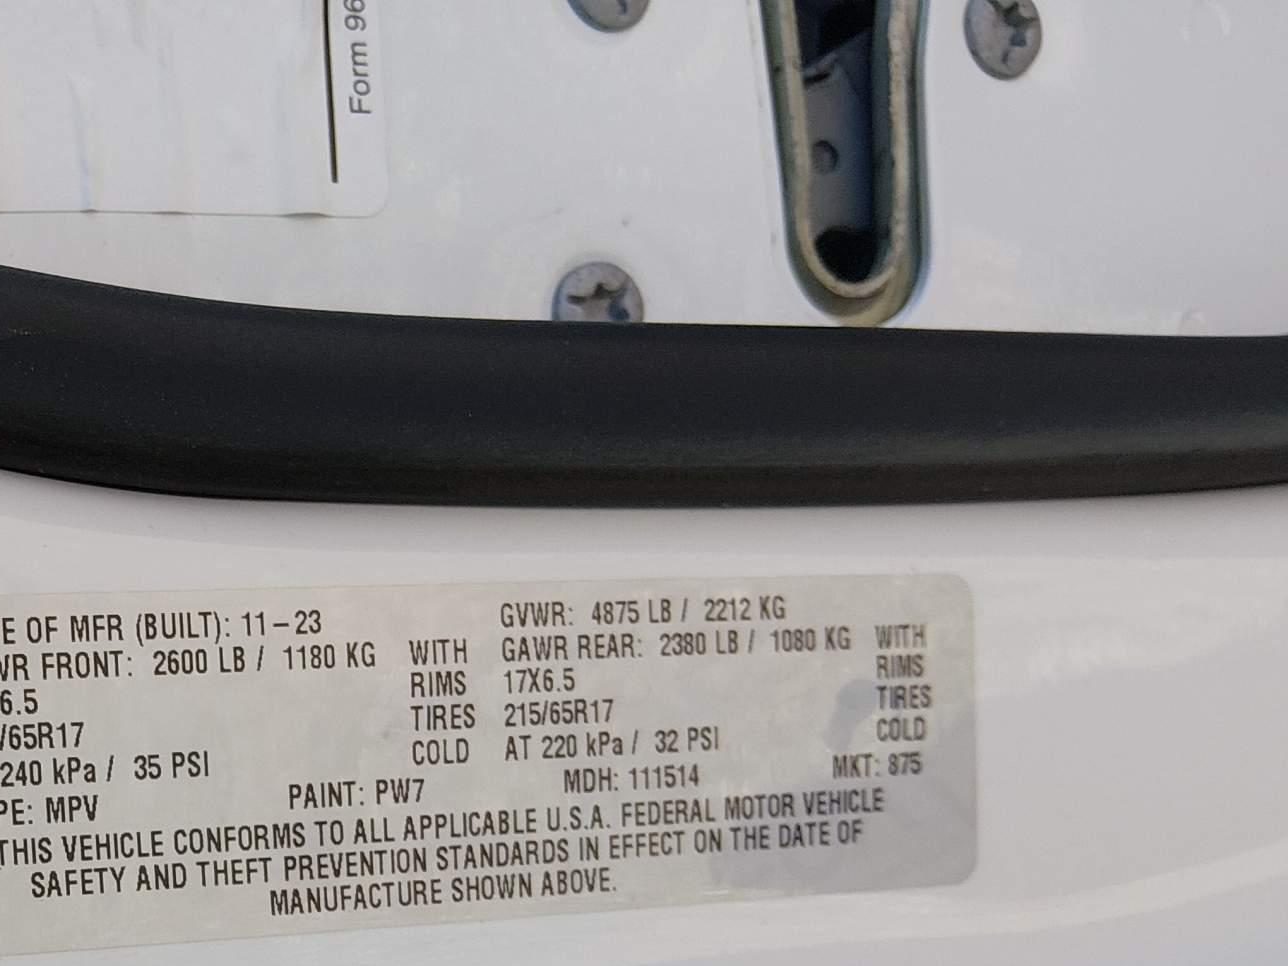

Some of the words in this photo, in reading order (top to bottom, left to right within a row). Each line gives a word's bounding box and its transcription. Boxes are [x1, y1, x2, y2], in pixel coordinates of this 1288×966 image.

[349, 41, 373, 114] Form
[501, 601, 573, 628] GVWR:
[592, 600, 639, 625] 4875
[649, 598, 671, 623] LB
[704, 597, 751, 622] 2212
[759, 596, 786, 620] KG
[27, 616, 57, 643] OF
[71, 615, 123, 642] MFR
[136, 611, 229, 647] (BUILT):
[875, 624, 926, 649] WITH
[409, 639, 467, 665] WITH
[502, 635, 568, 662] GAWR
[578, 633, 642, 659] REAR:
[660, 632, 706, 656] 2380
[716, 630, 738, 654] LB
[770, 628, 816, 652] 1080
[825, 626, 851, 650] KG
[42, 650, 132, 680] FRONT:
[153, 649, 207, 675] 2600
[219, 646, 245, 672] LB
[283, 644, 335, 670] 1180
[347, 642, 375, 668] KG
[876, 654, 924, 678] RIMS
[411, 671, 466, 698] RIMS
[504, 668, 575, 693] 17X6.5
[876, 685, 932, 710] TIRES
[410, 704, 475, 731] TIRES
[504, 699, 613, 727] 215/65R17
[877, 716, 926, 742] COLD
[412, 738, 469, 765] COLD
[505, 735, 531, 761] AT
[542, 734, 577, 759] 220
[586, 731, 623, 757] kPa
[655, 729, 679, 753] 32
[688, 726, 718, 751] PSI
[0, 760, 42, 787] 240
[53, 757, 96, 784] kPa
[134, 754, 161, 780] 35
[172, 751, 208, 778] PSI
[564, 767, 618, 793] MDH:
[629, 764, 699, 790] 111514
[833, 753, 880, 779] MKT:
[888, 751, 923, 776] 875
[289, 781, 364, 809] PAINT:
[376, 778, 424, 804] PW7
[46, 795, 98, 823] MPV
[61, 831, 163, 862] VEHICLE
[174, 822, 305, 855] CONFORMS
[314, 820, 344, 846] TO
[354, 817, 395, 844] ALL
[403, 808, 536, 841] APPLICABLE
[547, 805, 610, 831] U.S.A.
[622, 799, 716, 827] FEDERAL
[725, 793, 795, 820] MOTOR
[803, 787, 884, 816] VEHICLE
[31, 866, 125, 898] SAFETY
[136, 863, 186, 891] AND
[196, 857, 272, 887] THEFT
[284, 848, 426, 881] PREVENTION
[436, 838, 569, 871] STANDARDS
[579, 836, 599, 861] IN
[609, 831, 685, 859] EFFECT
[694, 828, 722, 853] ON
[729, 825, 769, 850] THE
[779, 821, 830, 848] DATE
[838, 819, 863, 844] OF
[270, 879, 442, 916] MANUFACTURE
[451, 873, 532, 902] SHOWN
[541, 867, 616, 896] ABOVE.
